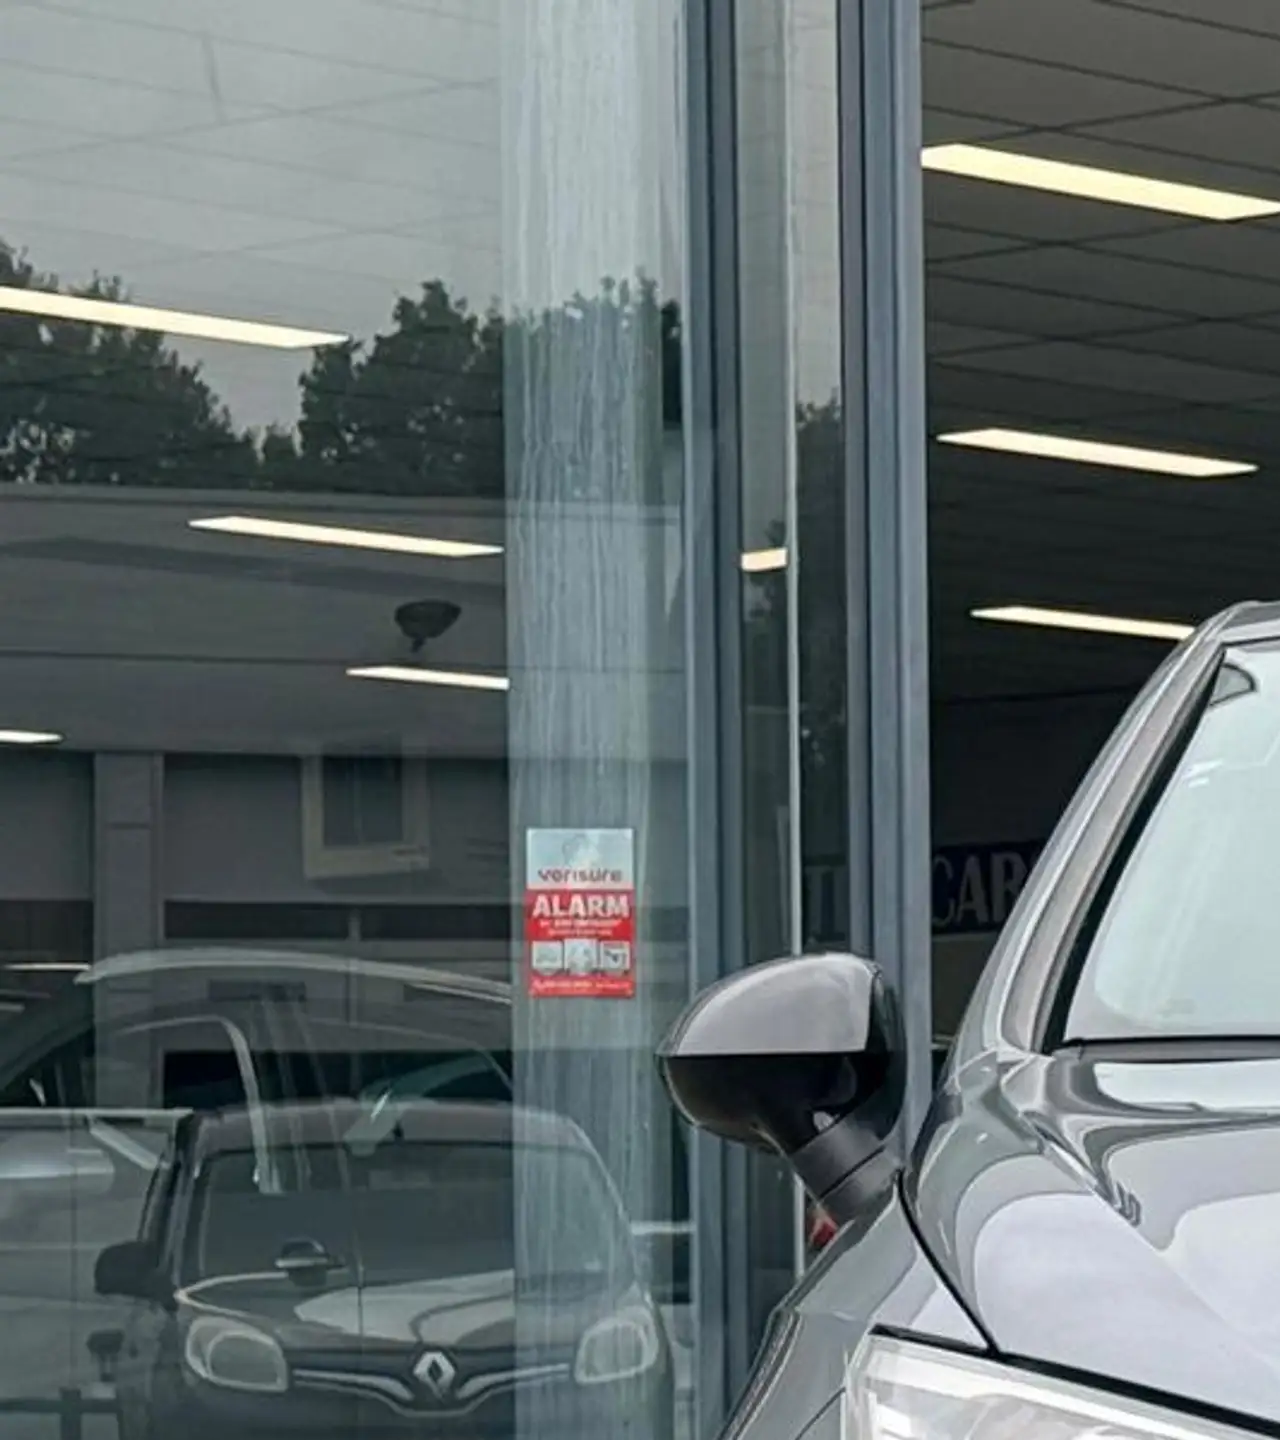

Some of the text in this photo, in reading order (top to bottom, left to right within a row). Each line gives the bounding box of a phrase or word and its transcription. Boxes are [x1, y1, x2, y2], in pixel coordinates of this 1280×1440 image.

[537, 868, 623, 883] verisure
[932, 851, 1040, 929] CAR
[532, 893, 630, 919] ALARM
